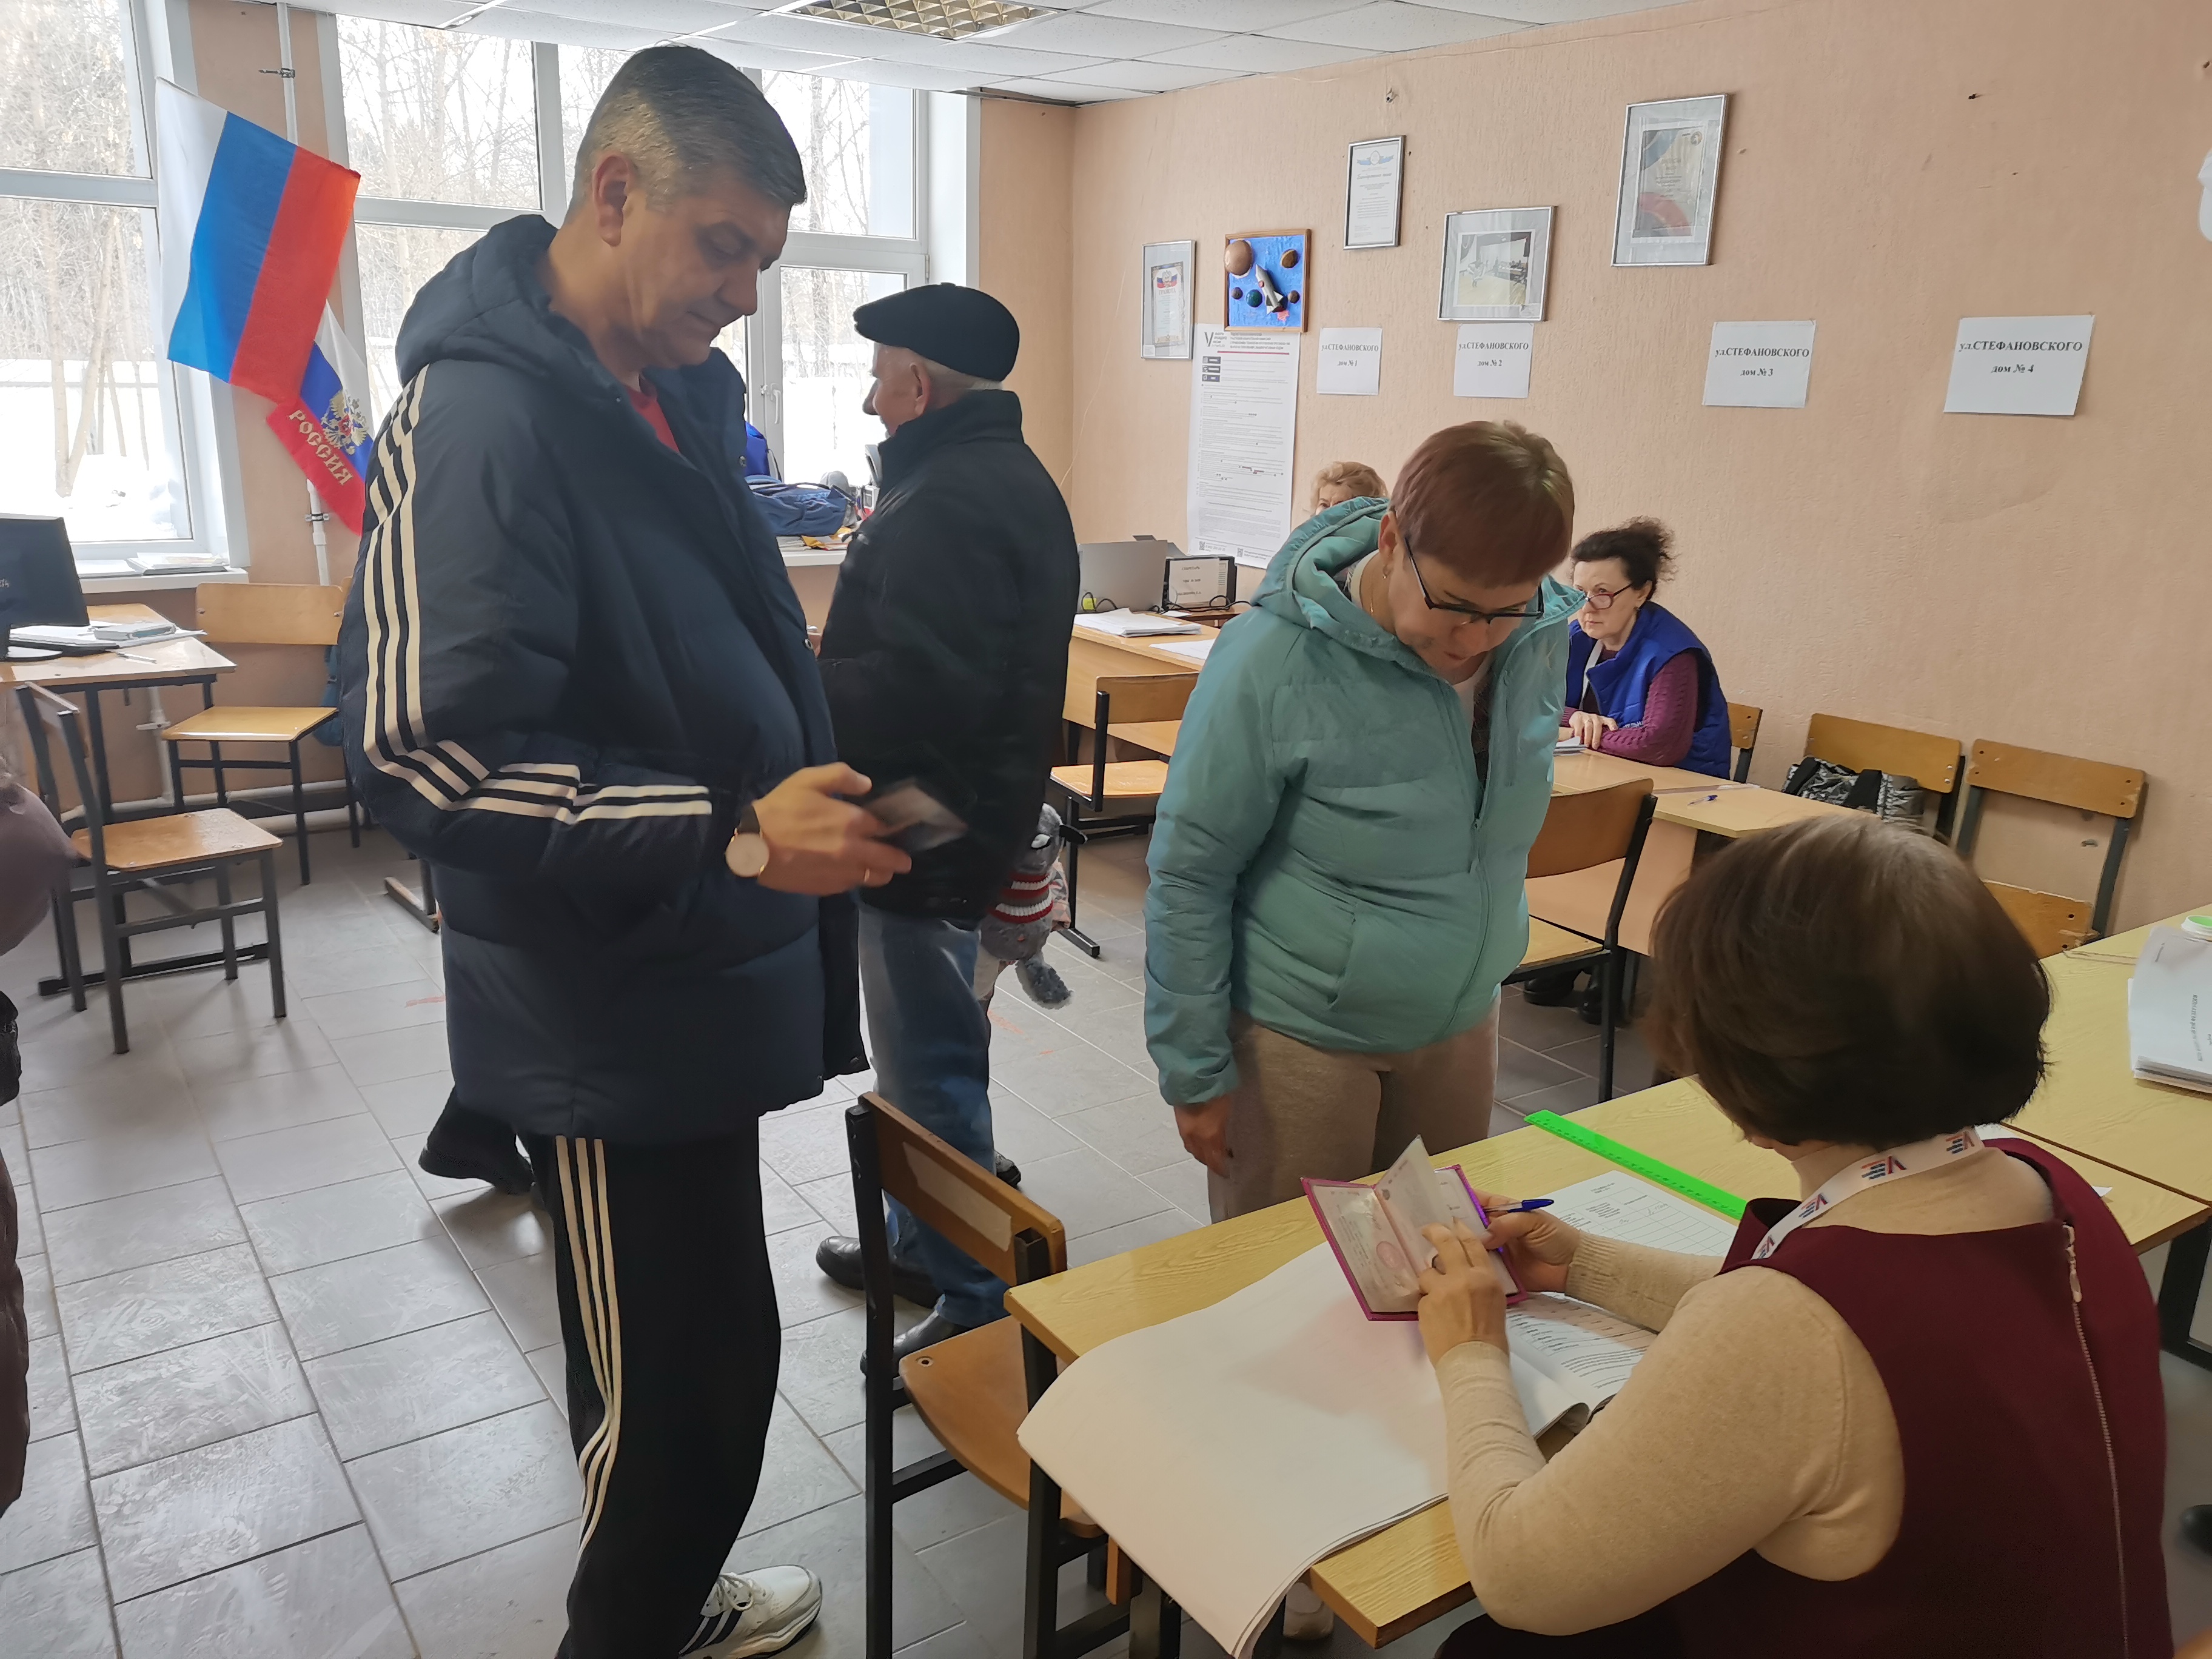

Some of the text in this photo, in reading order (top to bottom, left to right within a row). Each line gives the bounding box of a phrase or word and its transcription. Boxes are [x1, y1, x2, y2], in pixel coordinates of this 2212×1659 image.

[1959, 341, 2083, 352] ул.СТЕФАНОВСКОГО
[1715, 347, 1809, 358] ул.СТЕФАНОВСКОГО
[1757, 367, 1767, 376] №
[1768, 368, 1774, 377] 3
[2013, 364, 2026, 374] №
[2027, 364, 2034, 373] 4
[288, 409, 354, 486] РОССИЯ
